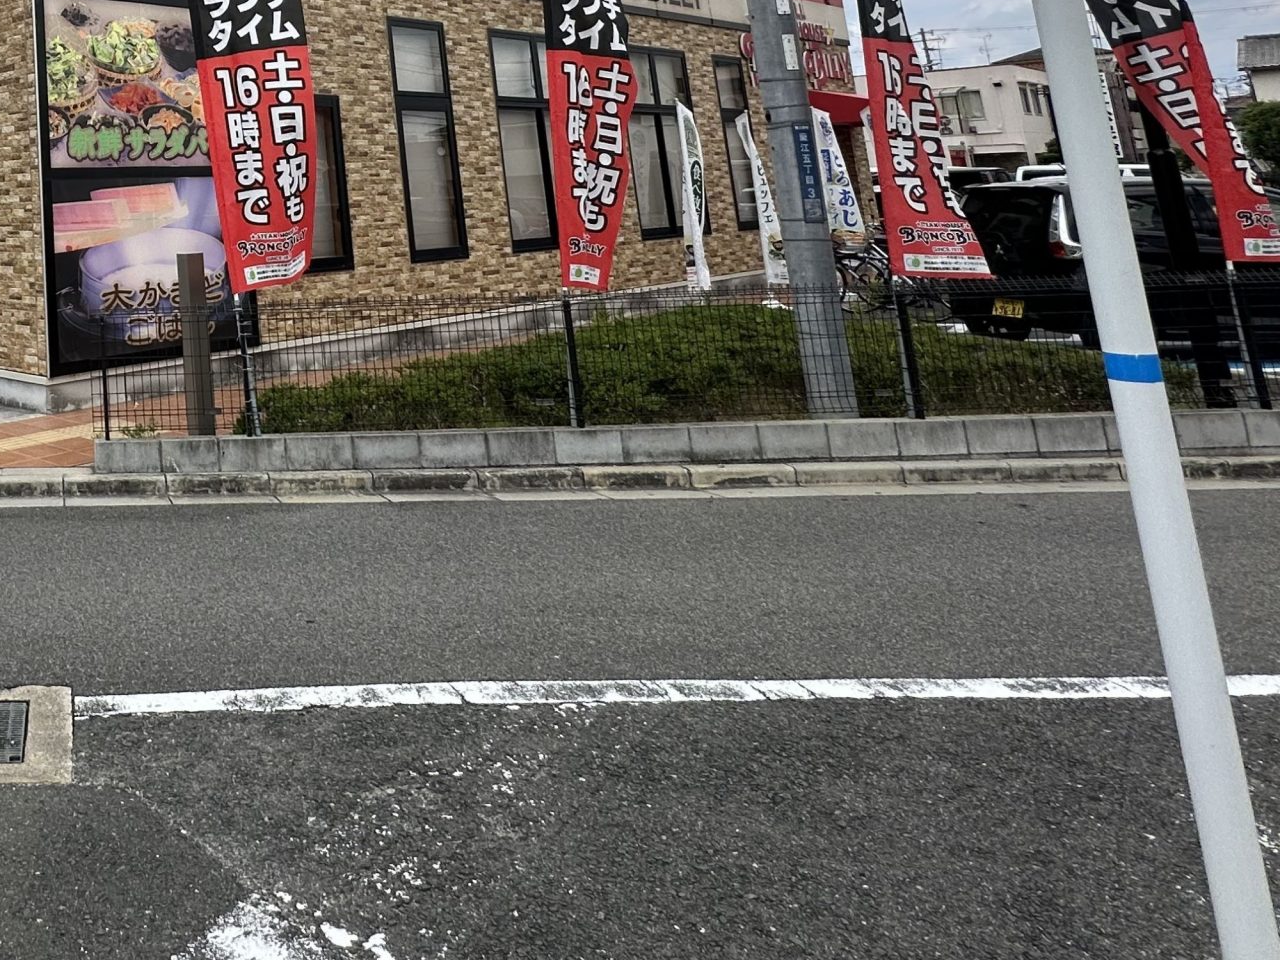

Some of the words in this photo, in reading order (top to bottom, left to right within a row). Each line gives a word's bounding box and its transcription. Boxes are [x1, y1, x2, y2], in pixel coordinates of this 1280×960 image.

[207, 9, 301, 53] タイム
[216, 66, 270, 225] 16時まで
[263, 51, 308, 224] 土・日・祝も
[877, 51, 927, 214] 16時まで
